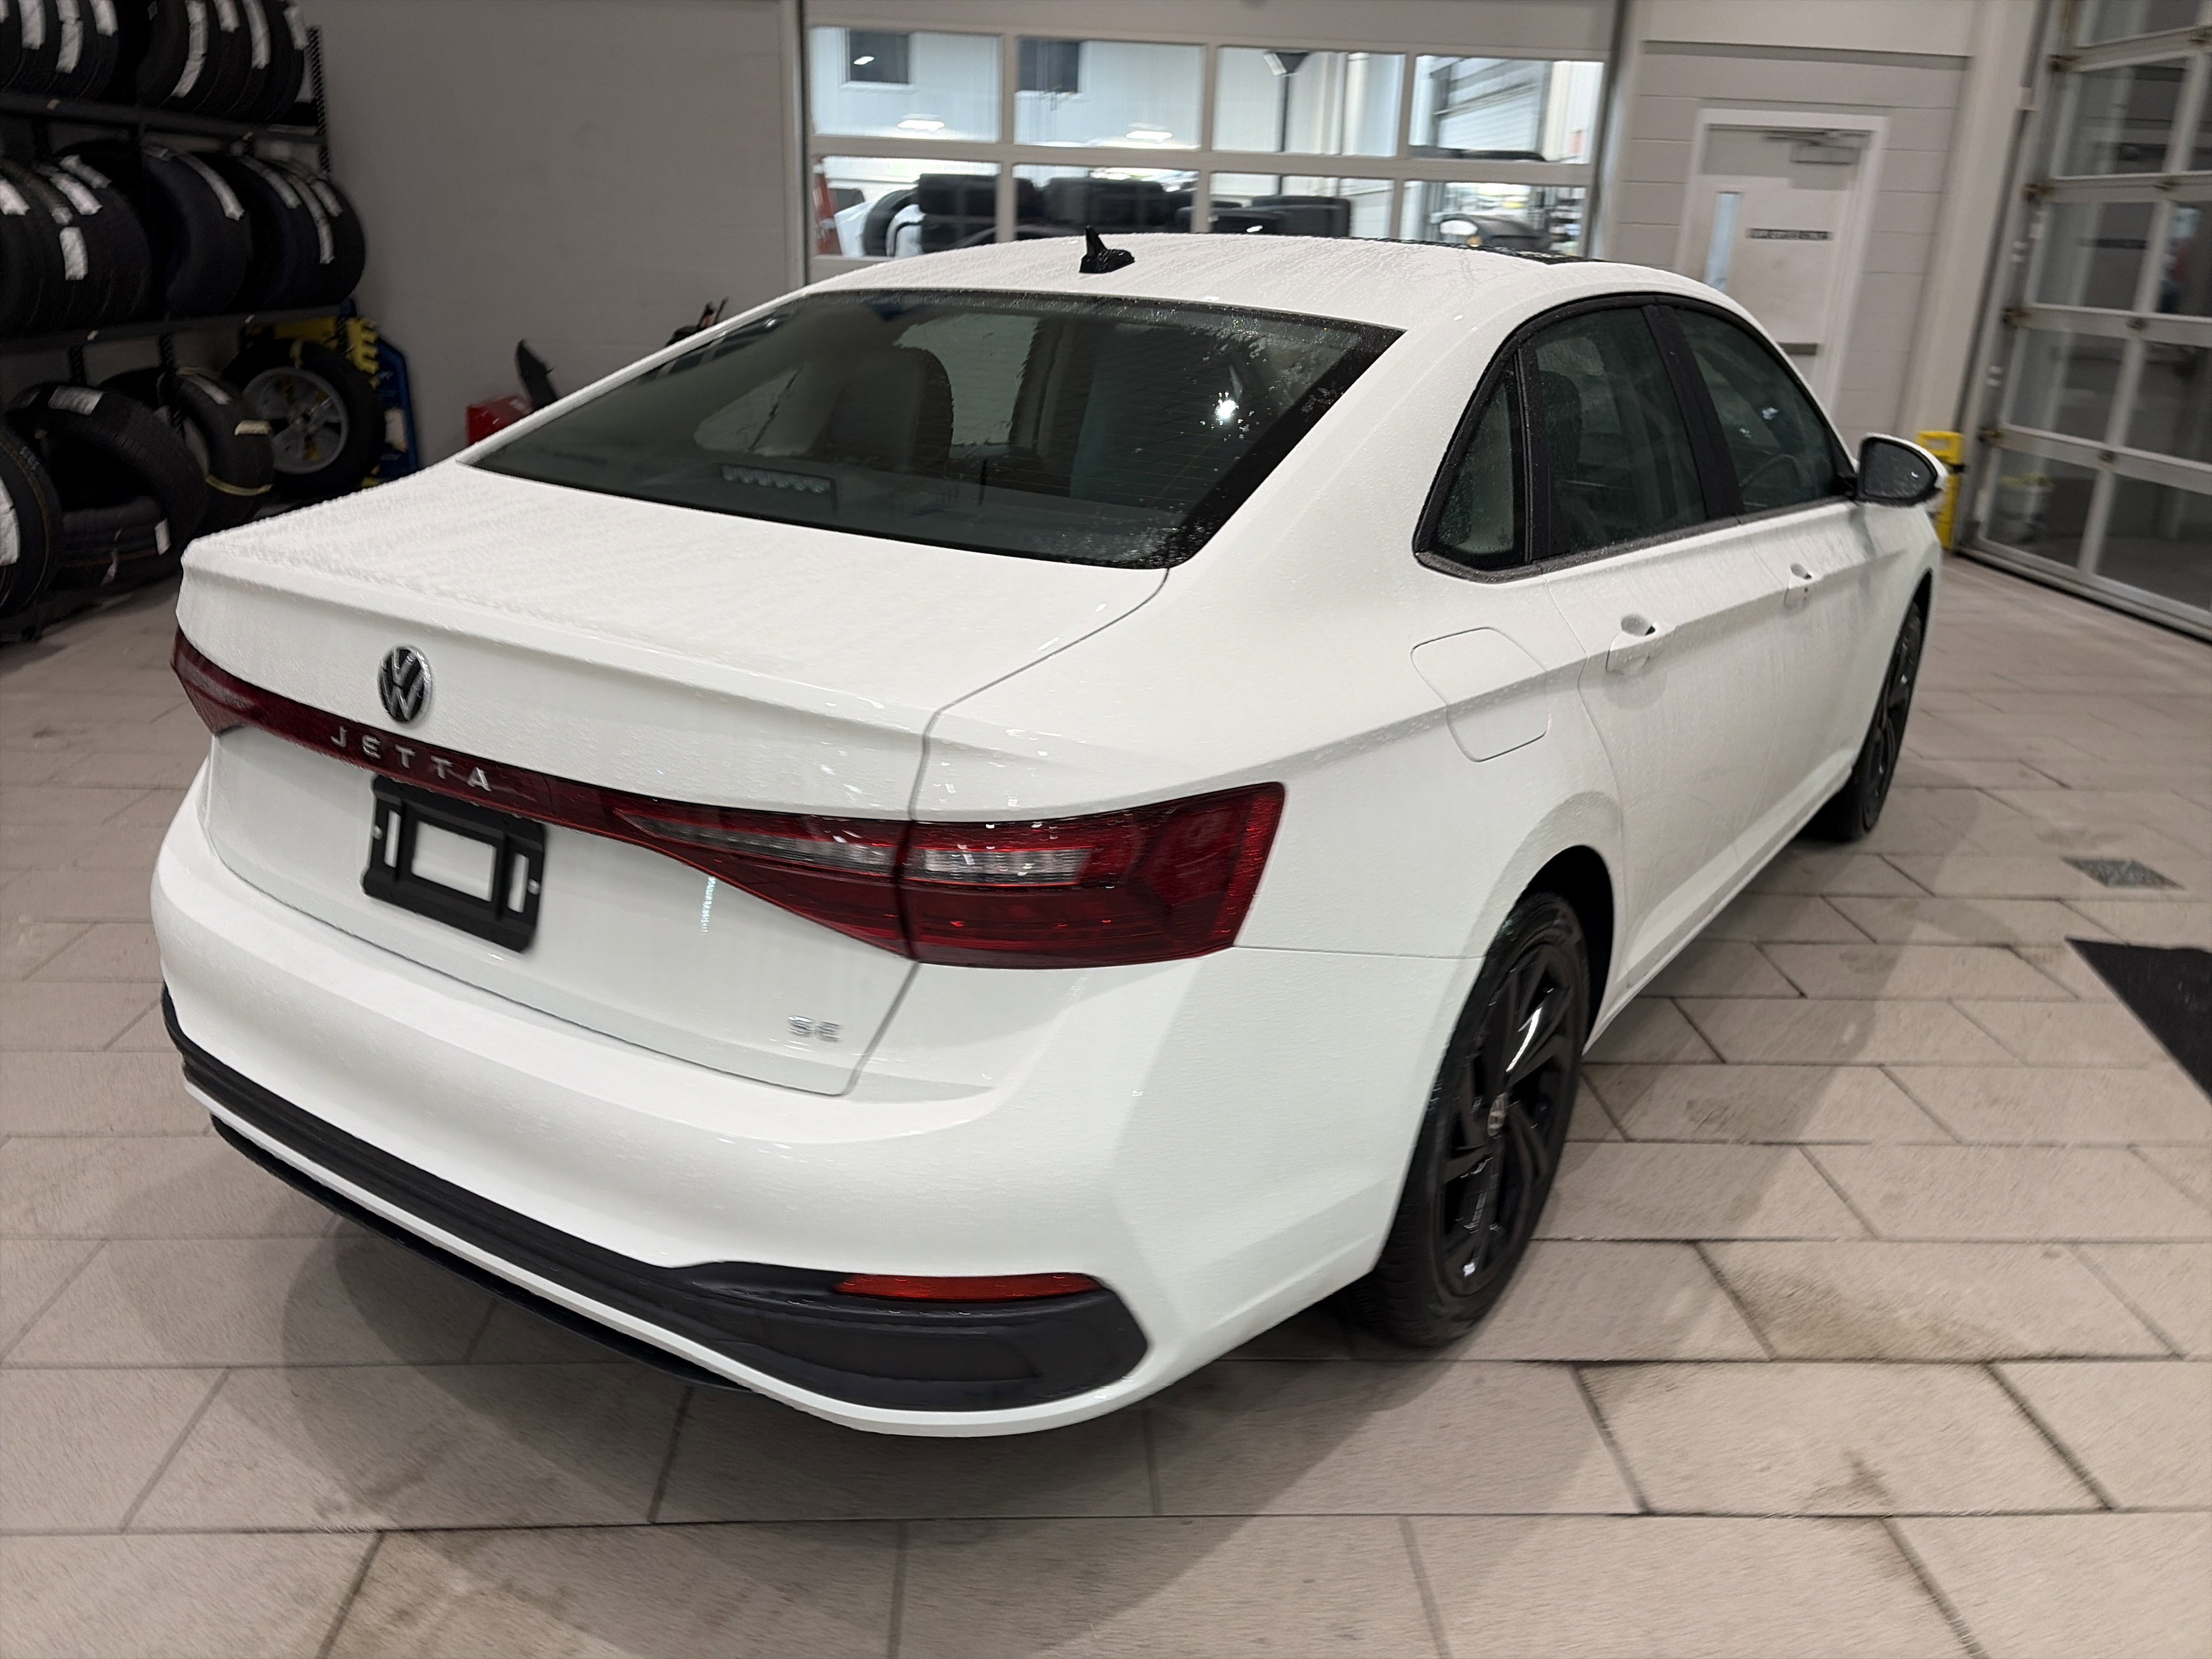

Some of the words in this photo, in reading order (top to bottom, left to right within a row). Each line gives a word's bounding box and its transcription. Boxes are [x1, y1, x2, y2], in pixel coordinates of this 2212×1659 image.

[379, 646, 431, 723] VW
[330, 725, 492, 792] JETTA
[787, 1015, 843, 1042] SE
